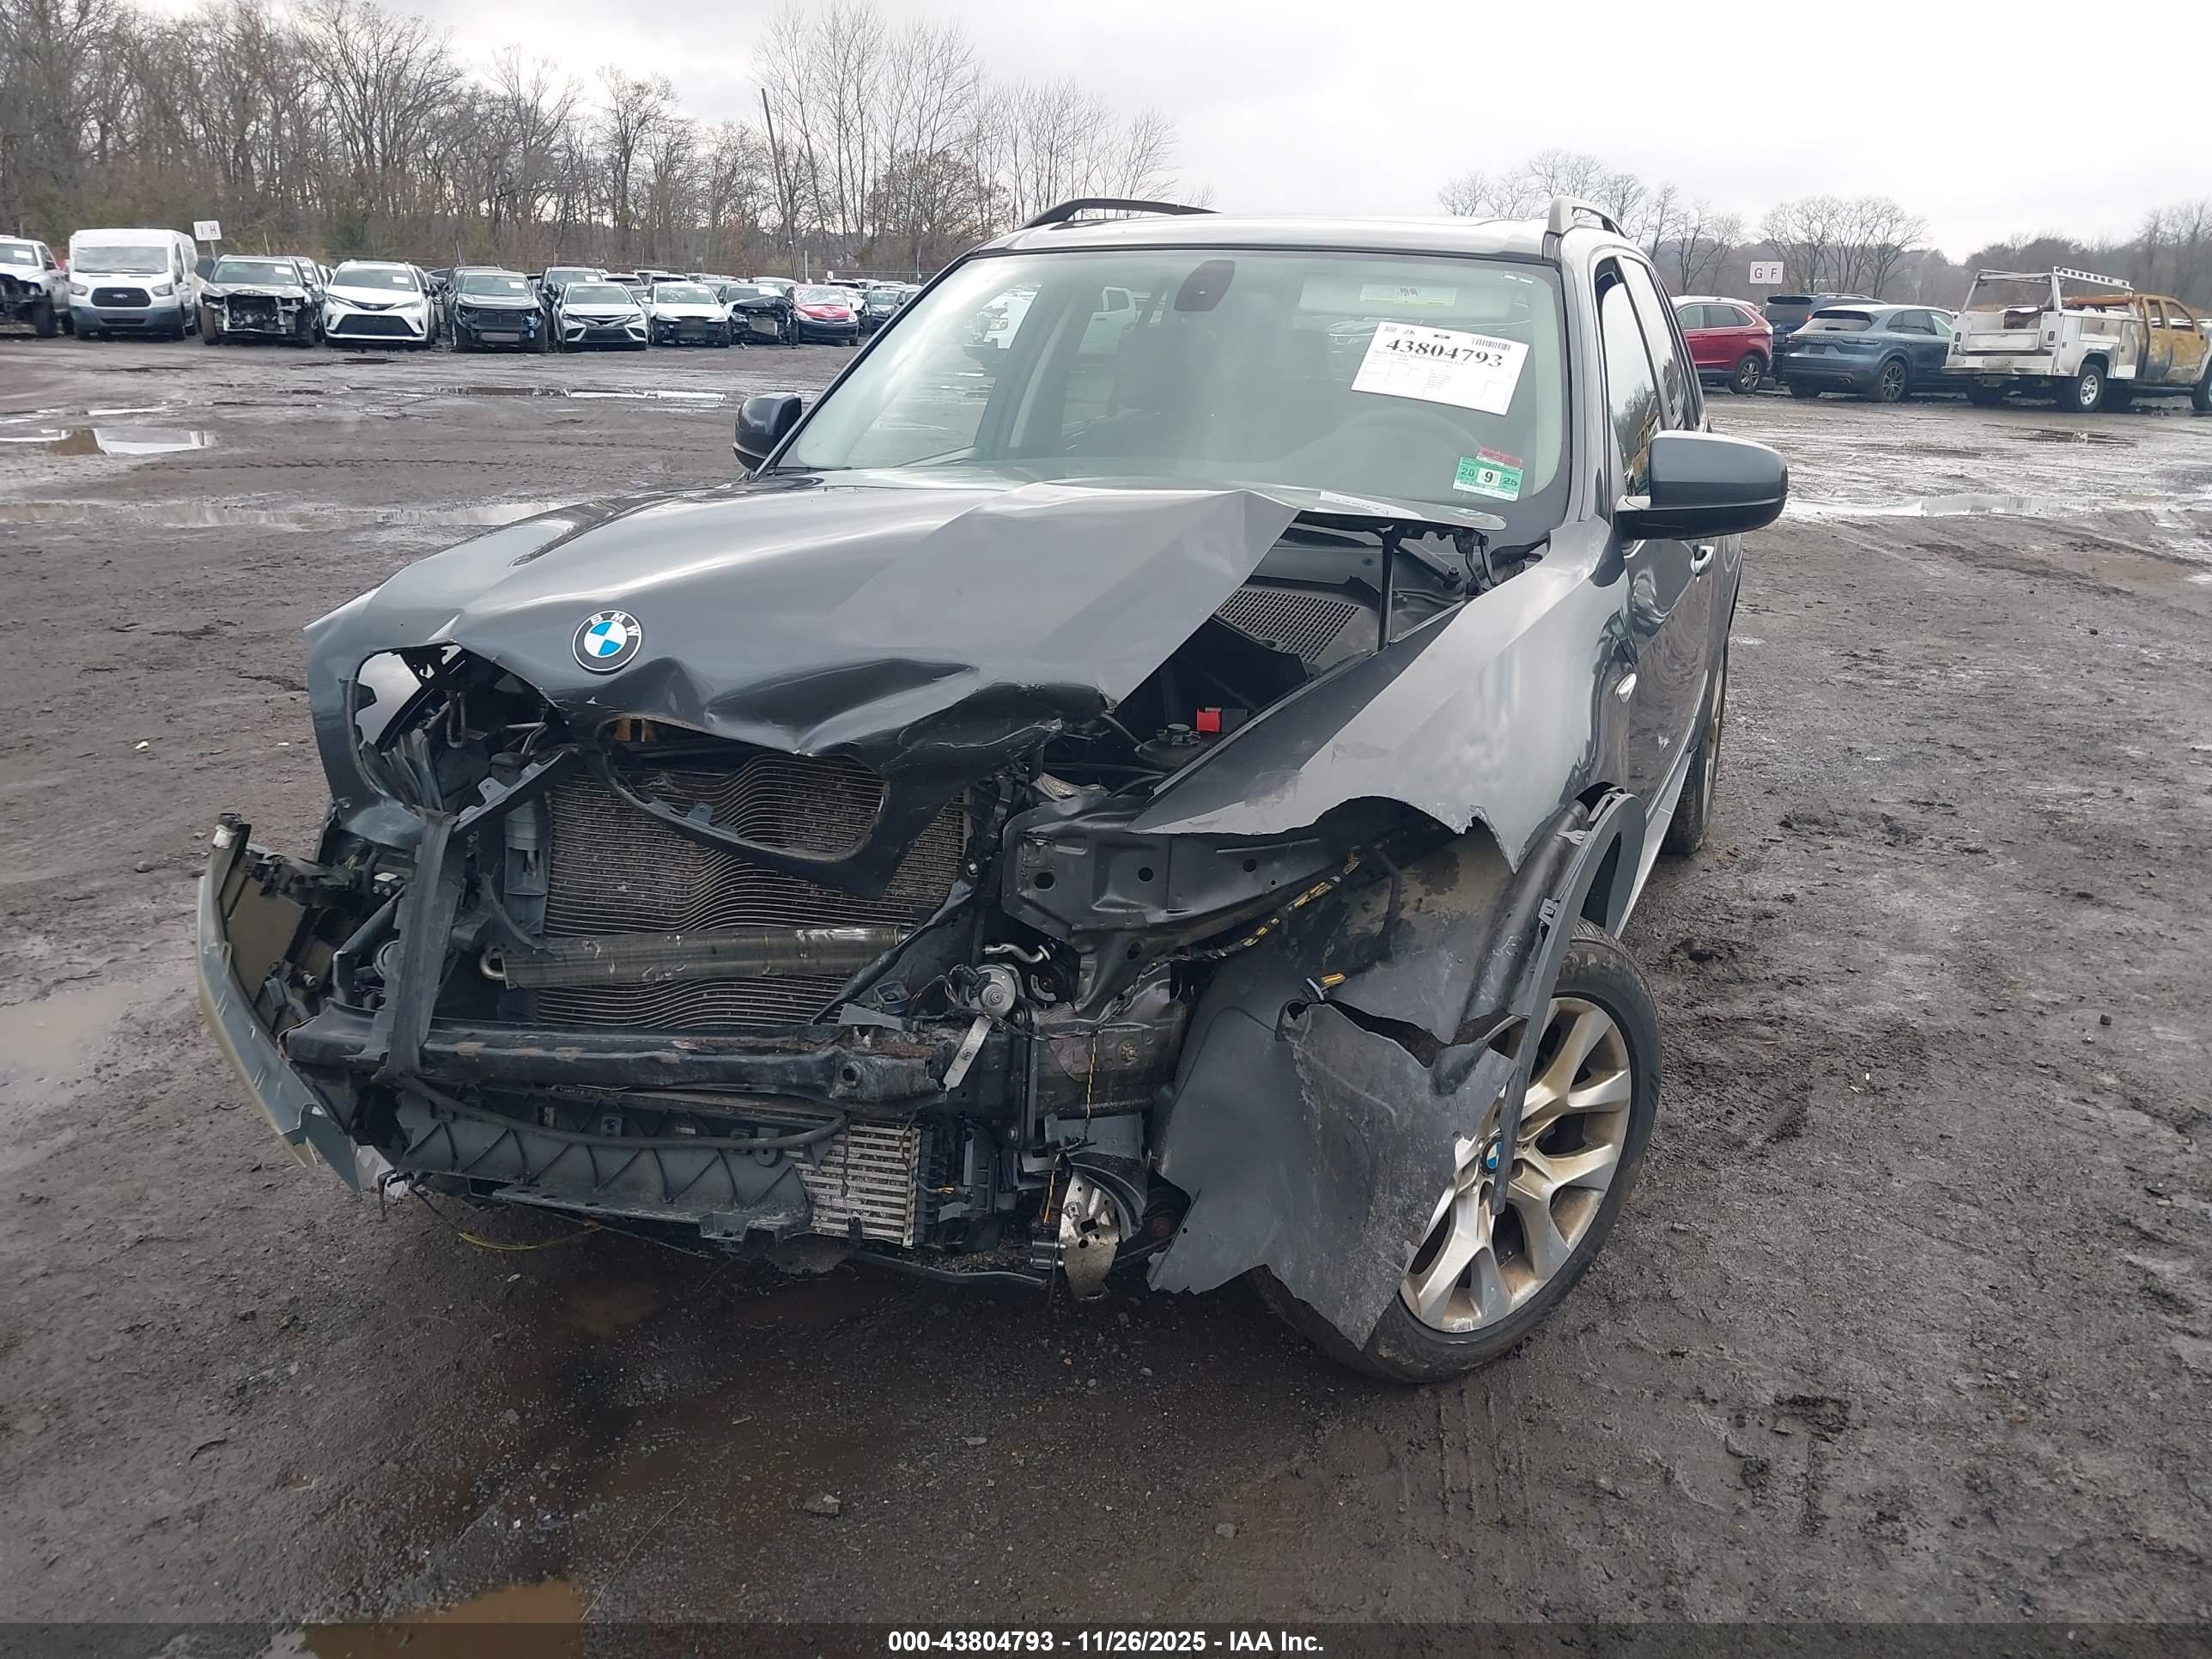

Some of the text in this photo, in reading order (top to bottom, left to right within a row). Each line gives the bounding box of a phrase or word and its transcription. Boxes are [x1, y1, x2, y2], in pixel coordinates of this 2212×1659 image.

[1754, 267, 1778, 279] G F
[1386, 338, 1504, 368] 43804793
[1461, 467, 1518, 487] 20 9 25
[590, 611, 640, 636] BMW
